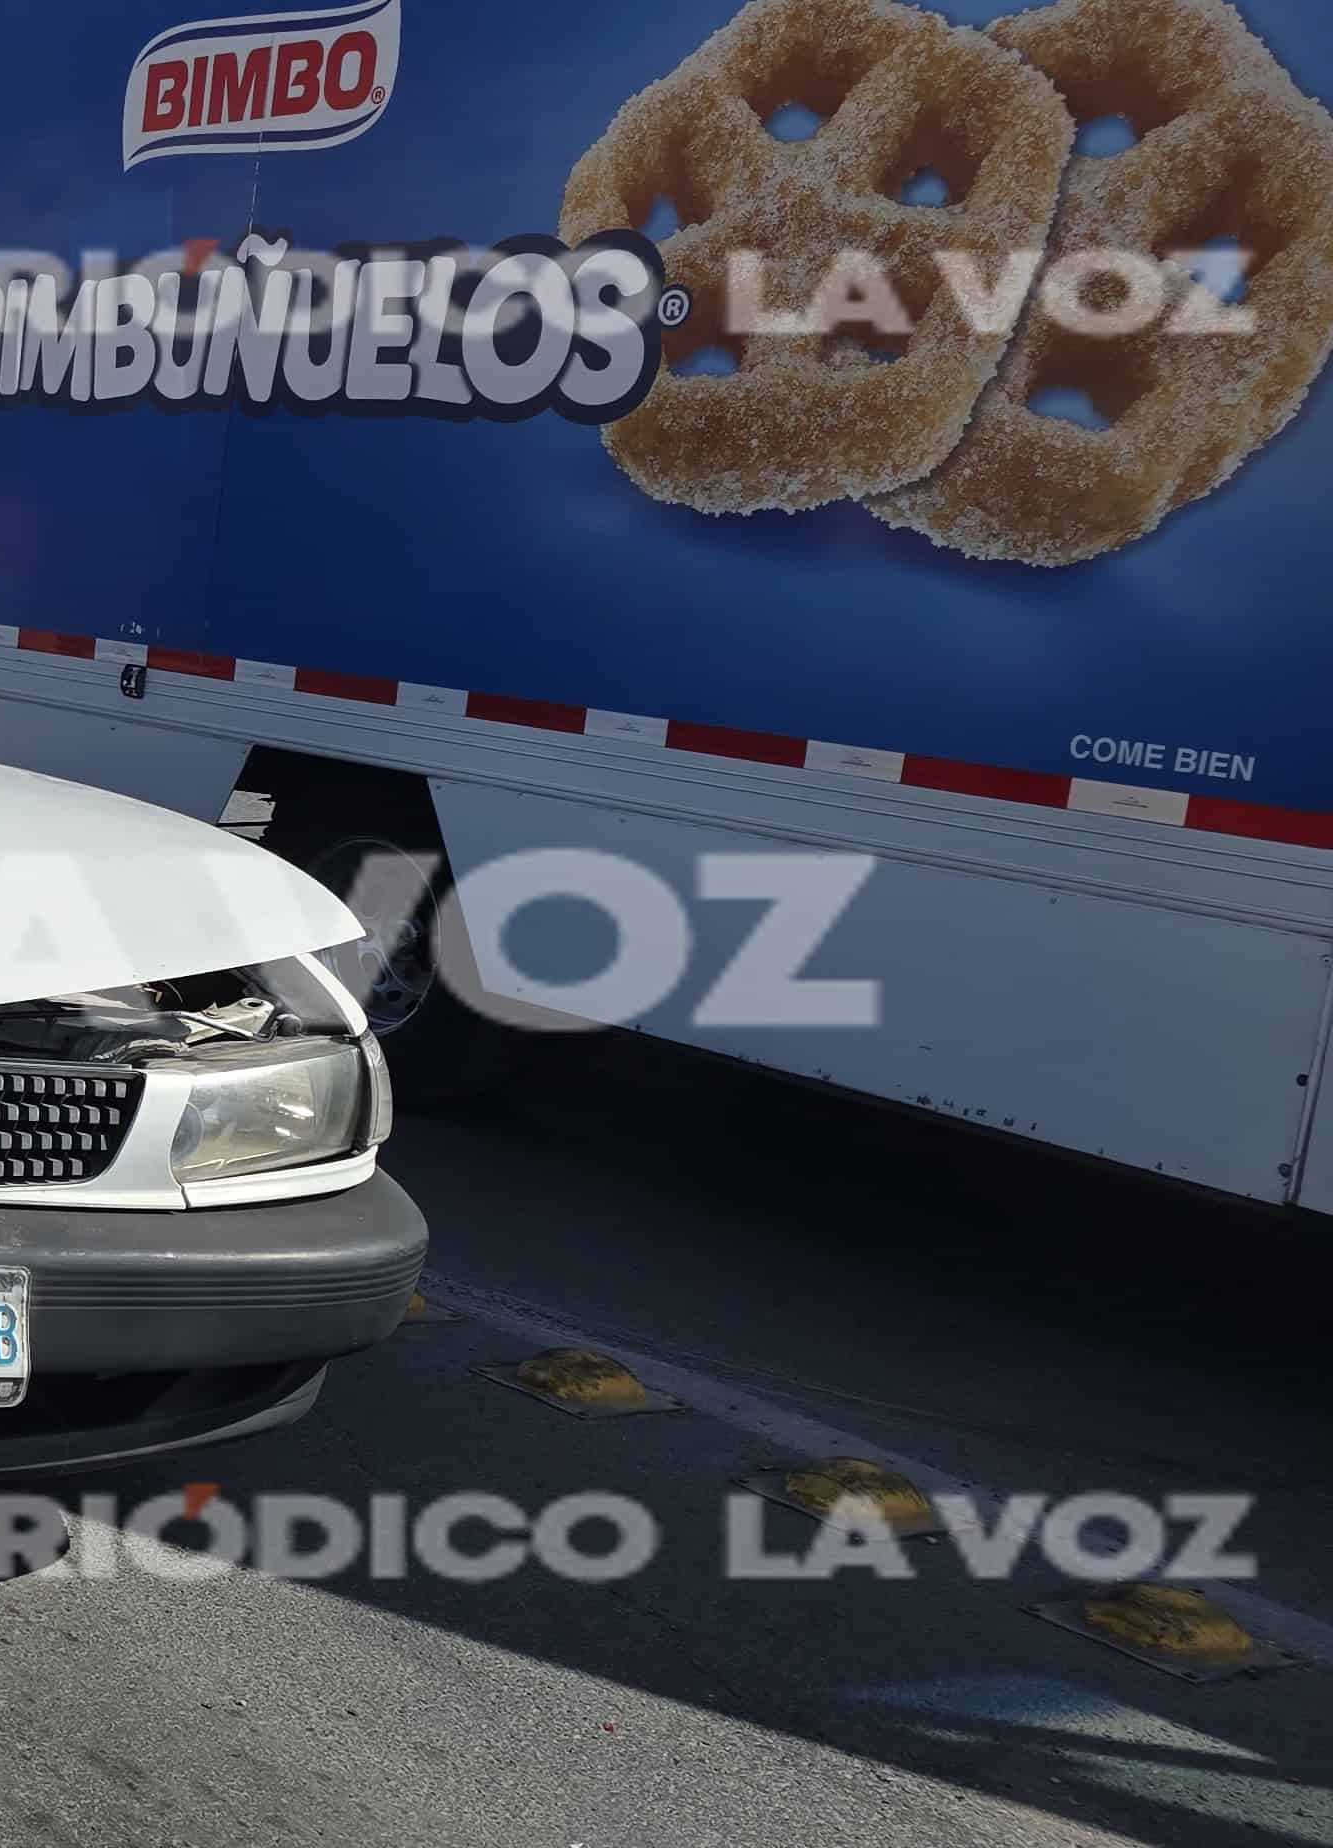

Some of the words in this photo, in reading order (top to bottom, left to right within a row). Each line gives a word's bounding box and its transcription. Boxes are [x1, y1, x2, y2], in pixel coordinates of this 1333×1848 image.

[142, 30, 378, 133] BIMBO
[1070, 734, 1166, 769] COME
[1173, 747, 1256, 781] BIEN
